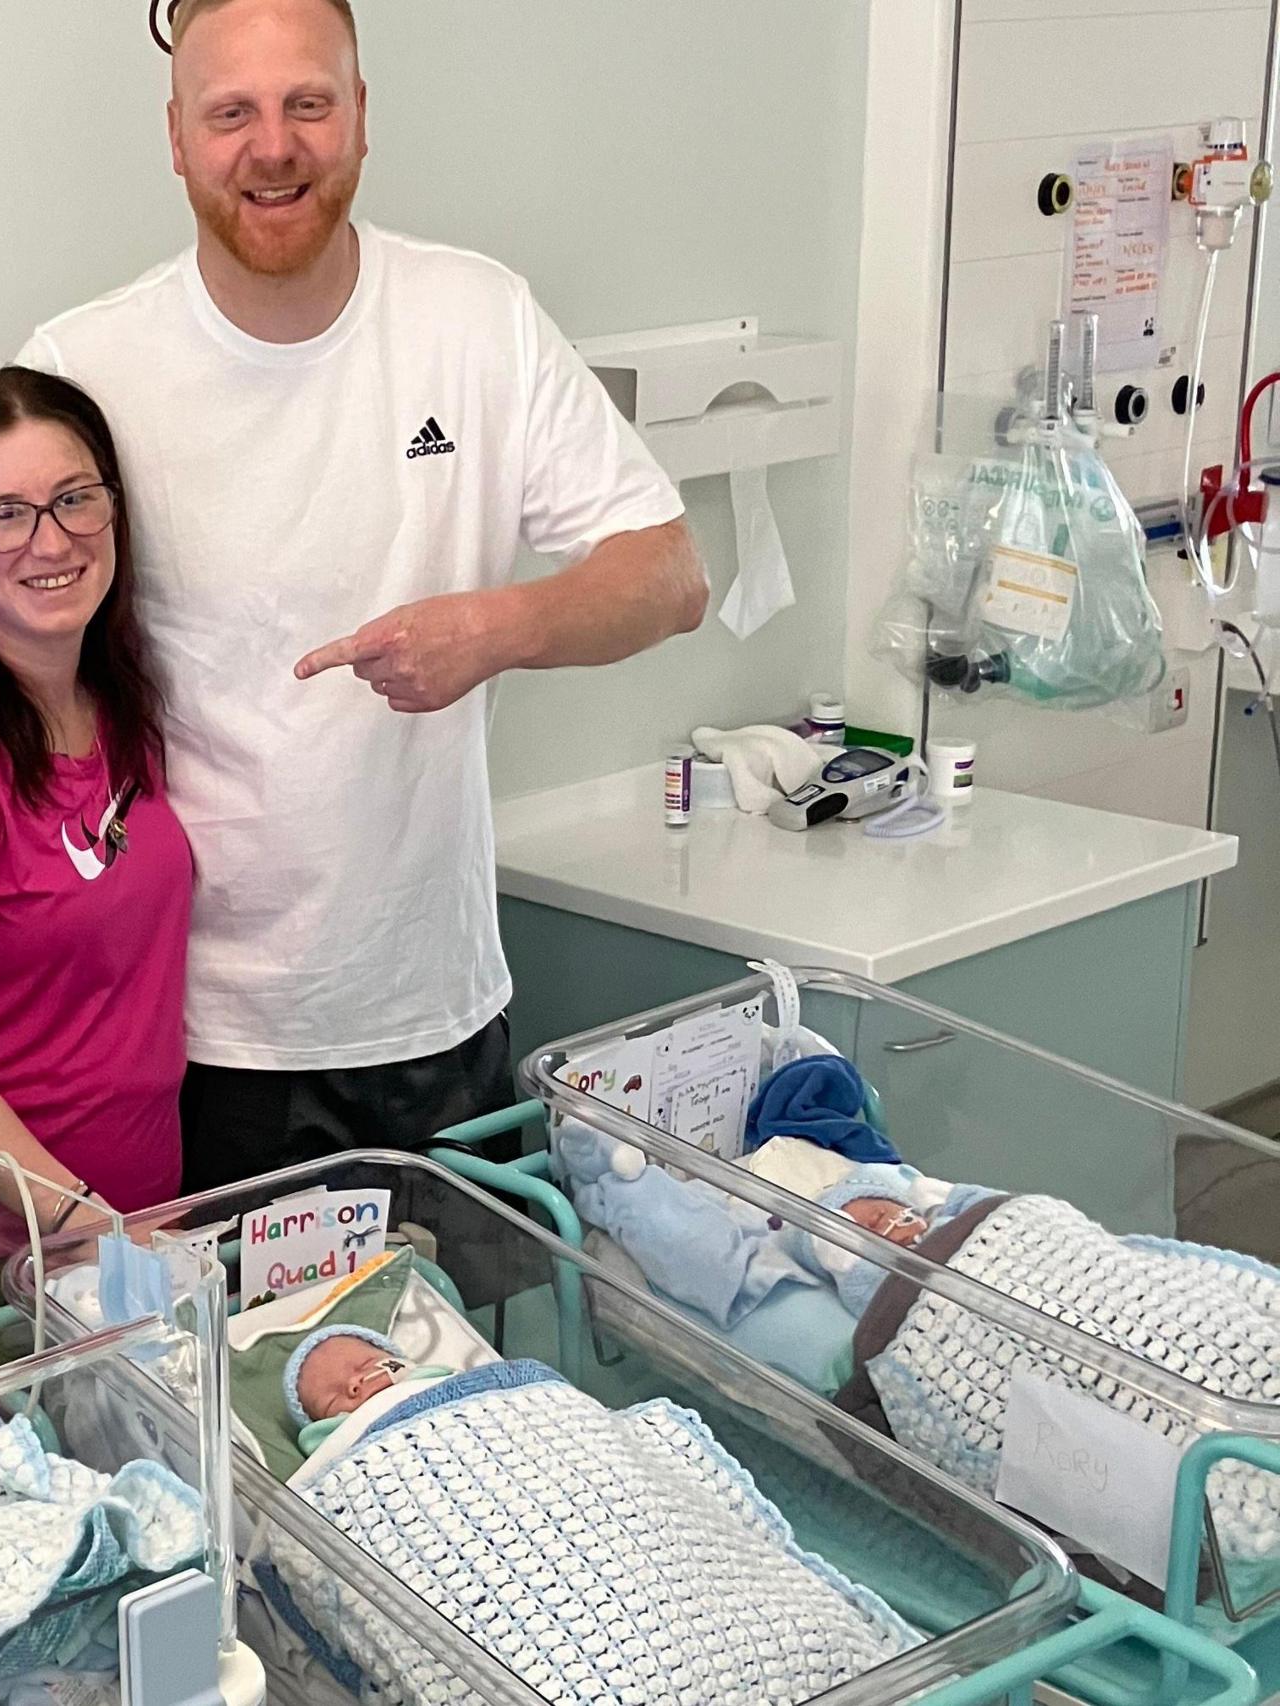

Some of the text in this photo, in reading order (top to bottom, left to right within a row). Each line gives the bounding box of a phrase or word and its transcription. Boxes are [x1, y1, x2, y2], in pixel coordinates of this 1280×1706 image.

[406, 441, 456, 459] adidas
[251, 1202, 379, 1245] Harrison
[267, 1250, 356, 1290] Quad 1
